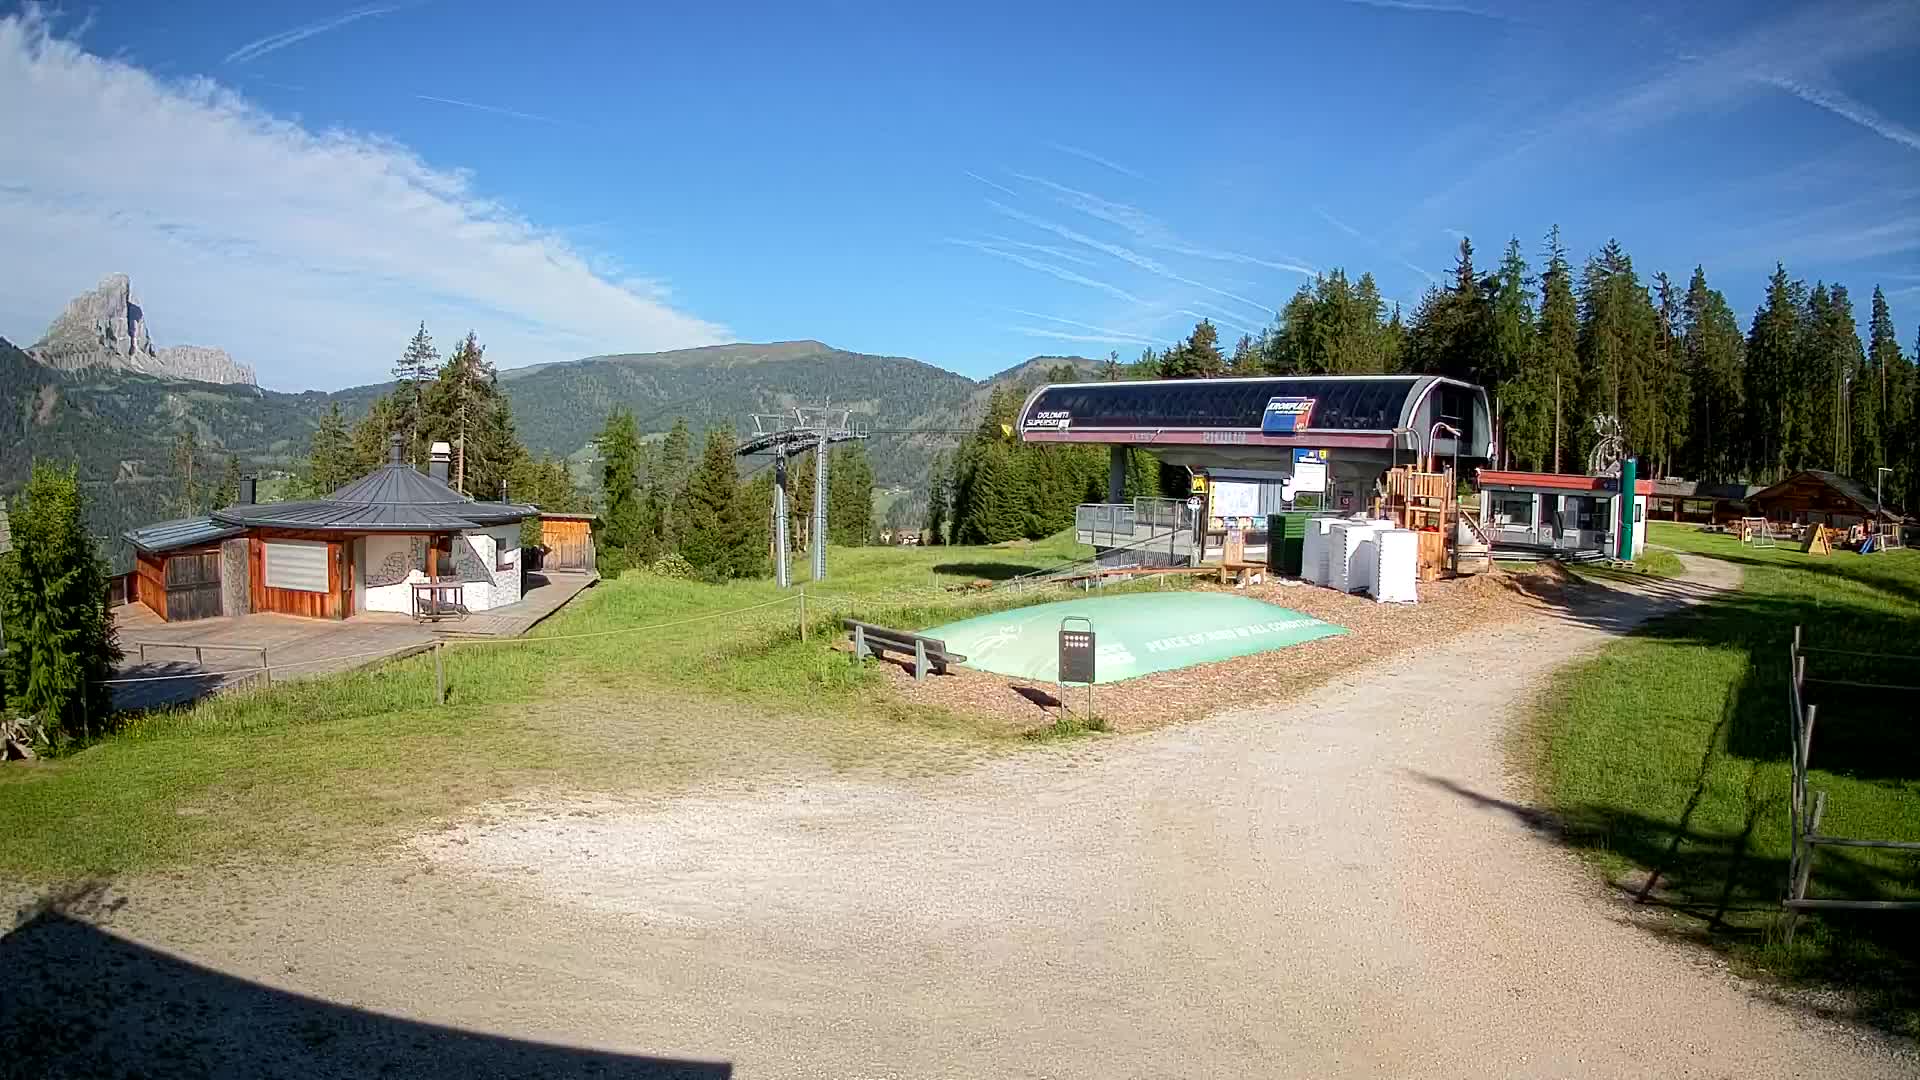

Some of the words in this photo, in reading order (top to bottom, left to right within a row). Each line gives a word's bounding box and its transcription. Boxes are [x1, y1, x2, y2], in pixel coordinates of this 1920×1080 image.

[1037, 411, 1069, 419] DOLOMITI
[1145, 637, 1189, 652] PEACE
[1248, 623, 1268, 634] ALL
